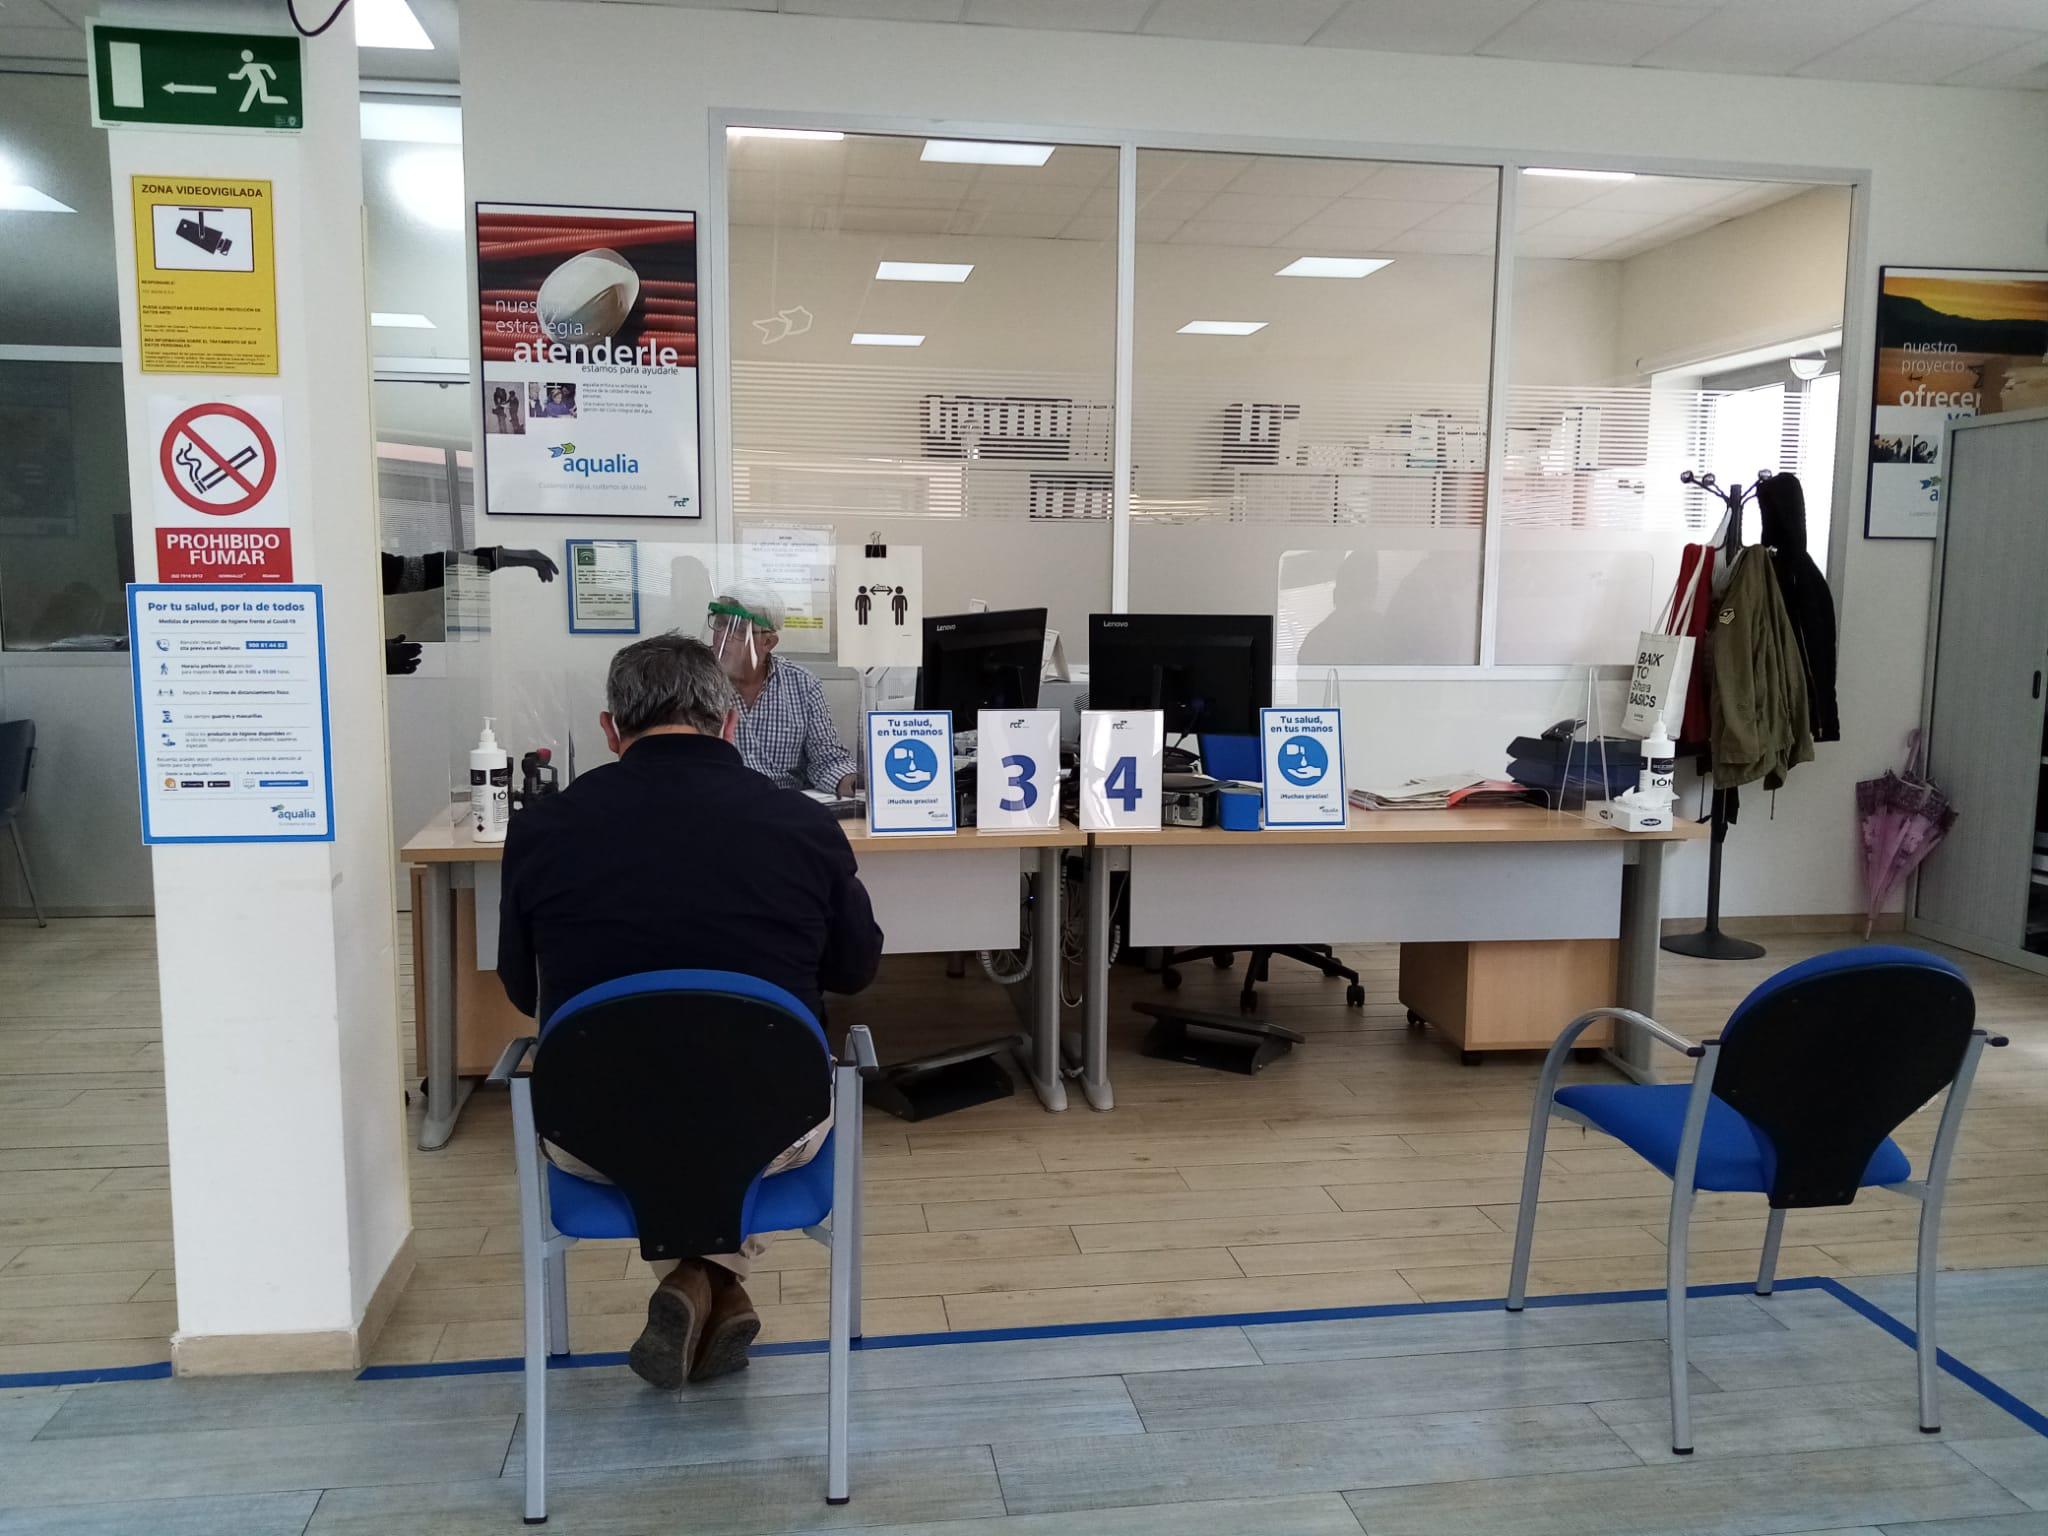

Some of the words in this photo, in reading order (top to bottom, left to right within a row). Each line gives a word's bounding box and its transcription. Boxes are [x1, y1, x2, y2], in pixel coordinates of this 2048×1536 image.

[142, 185, 173, 194] ZONA
[176, 186, 263, 198] VIDEOVIGILADA
[495, 318, 600, 339] estraegia...
[513, 337, 679, 367] atenderle
[1903, 341, 1958, 353] nuestro
[581, 365, 618, 373] estamos
[619, 367, 640, 375] para
[641, 367, 679, 376] ayudarle
[563, 454, 639, 477] aqualia
[166, 534, 280, 549] PROHIBIDO
[190, 550, 265, 565] FUMAR
[148, 602, 168, 612] Por
[170, 603, 182, 612] tu
[185, 602, 218, 613] salud,
[221, 604, 240, 613] por
[243, 602, 253, 612] la
[256, 602, 270, 612] de
[272, 603, 305, 612] todos
[936, 624, 956, 632] Lenovo
[1103, 620, 1129, 628] Lenovo
[1637, 666, 1650, 679] TO
[887, 719, 900, 727] Tu
[903, 719, 933, 728] salud,
[1280, 716, 1293, 724] Tu
[1294, 716, 1323, 725] salud,
[999, 754, 1038, 812] 3
[1104, 756, 1143, 812] 4
[277, 809, 316, 820] aqualia
